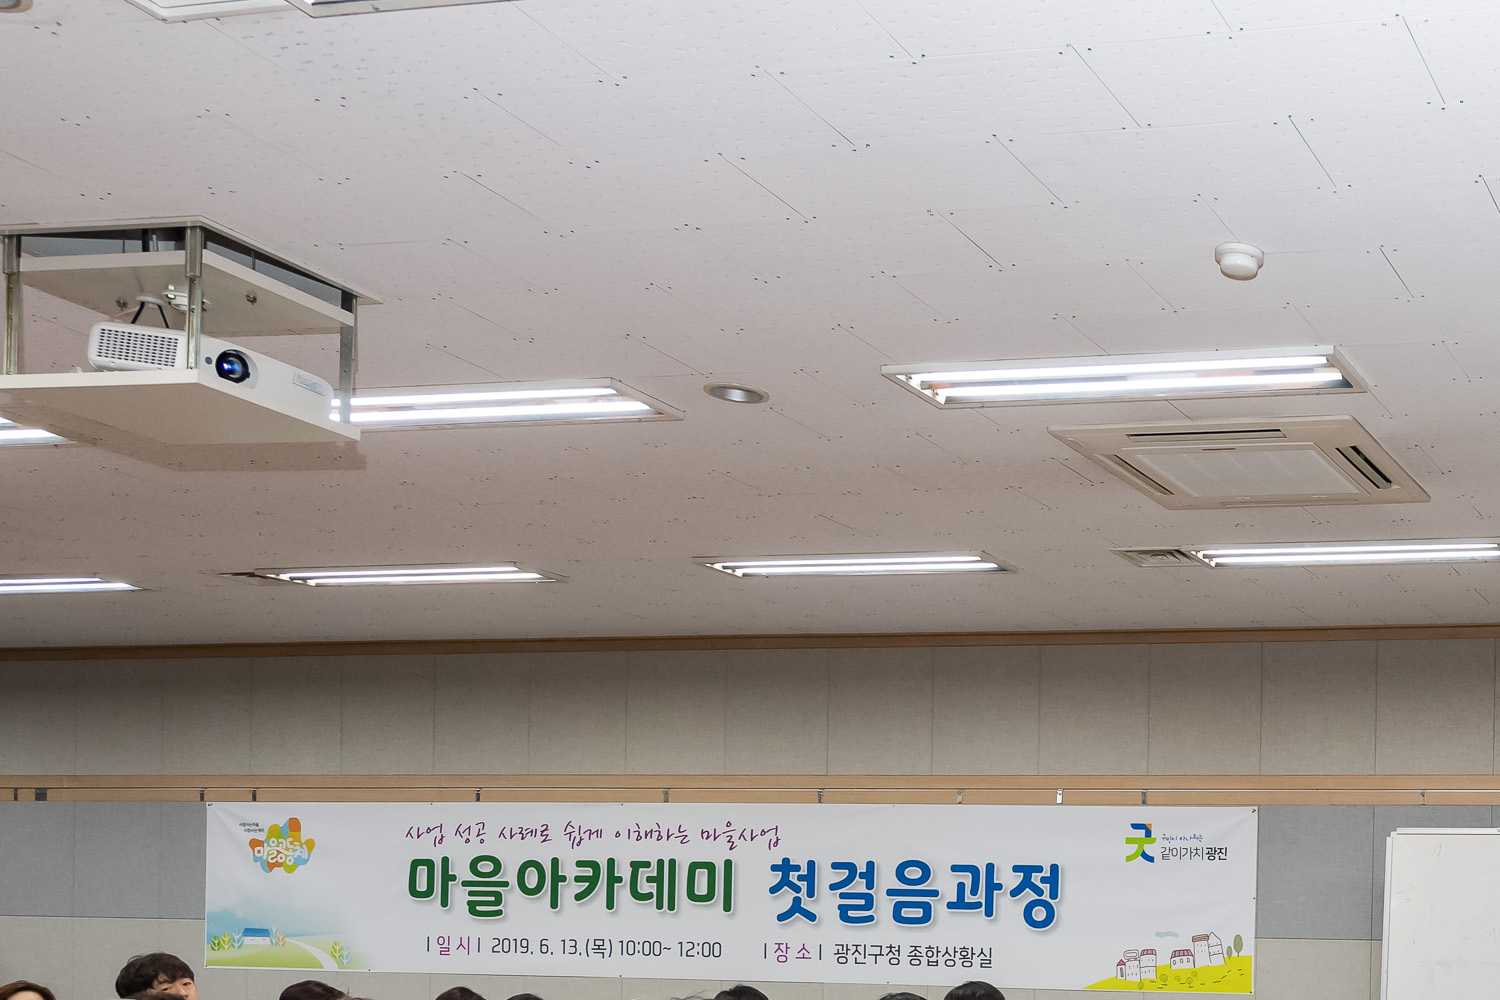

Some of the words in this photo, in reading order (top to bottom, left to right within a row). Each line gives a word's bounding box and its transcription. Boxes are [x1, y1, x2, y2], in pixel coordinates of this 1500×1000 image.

[405, 822, 446, 848] 사업
[454, 821, 487, 845] 성공
[498, 823, 553, 844] 사례로
[563, 820, 603, 850] 쉽게
[614, 822, 691, 845] 이해하는
[700, 820, 782, 852] 마을사업
[1160, 846, 1204, 861] 같이가치
[1205, 846, 1228, 862] 광진
[408, 854, 733, 918] 마을아카데미
[768, 856, 1062, 930] 첫걸음과정
[491, 937, 534, 955] 2019.
[539, 938, 554, 956] 6.
[677, 941, 722, 959] 12:00
[833, 943, 901, 966] 광진구청
[906, 944, 993, 969] 종합상황실
